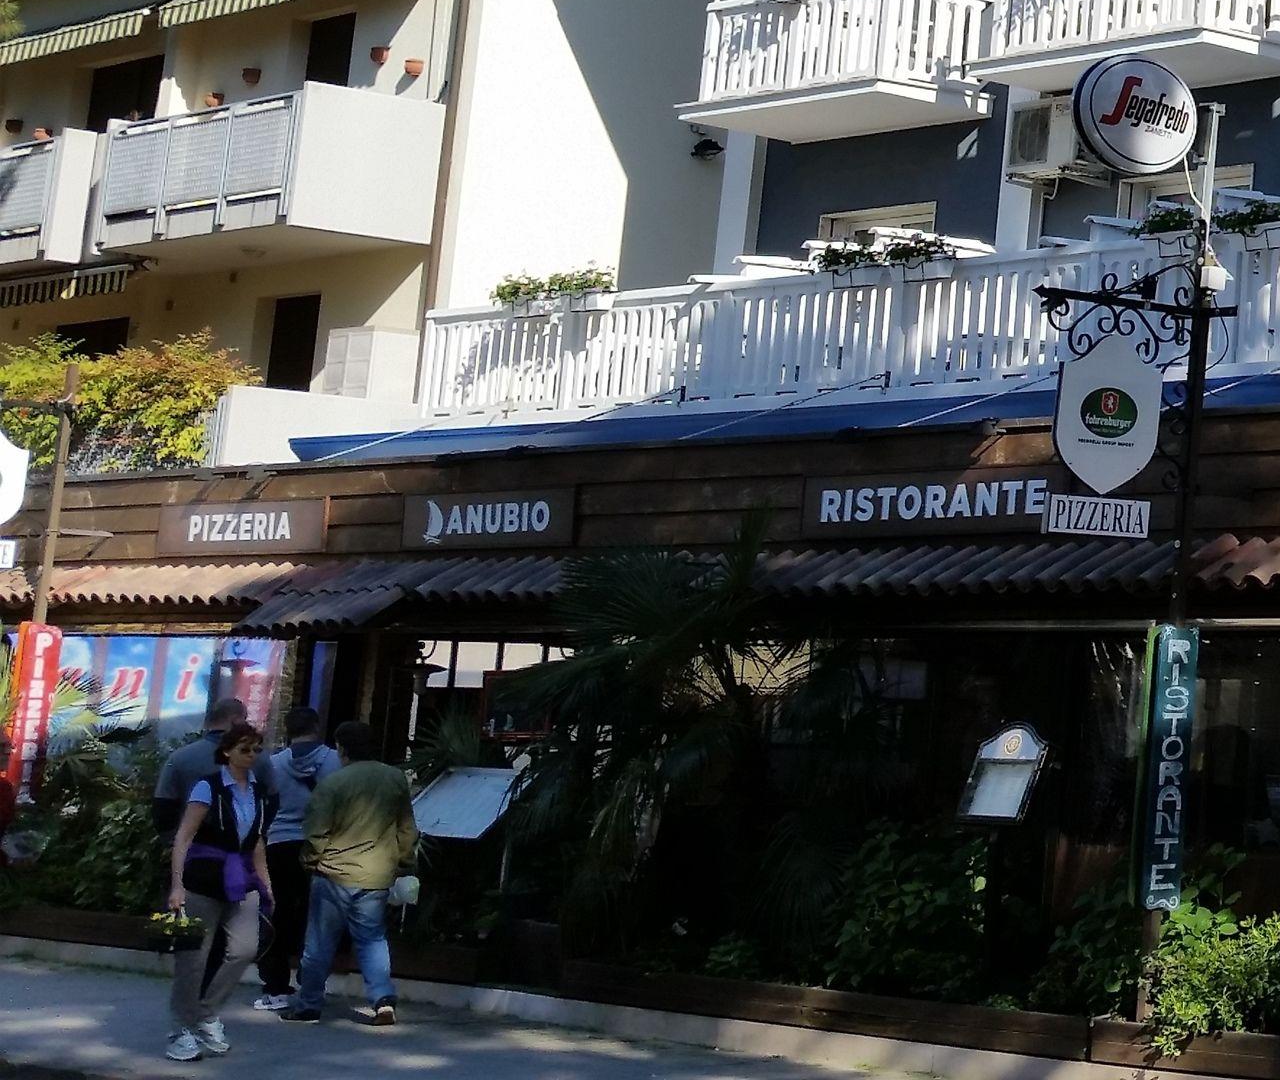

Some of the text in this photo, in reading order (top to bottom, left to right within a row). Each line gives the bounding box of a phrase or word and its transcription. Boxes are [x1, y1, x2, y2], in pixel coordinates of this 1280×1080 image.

[1099, 75, 1190, 135] Segafredo
[819, 478, 1048, 523] RISTORANTE
[1053, 498, 1145, 535] PIZZERIA
[187, 511, 291, 542] PIZZERIA
[1150, 639, 1190, 891] RISTORANTE
